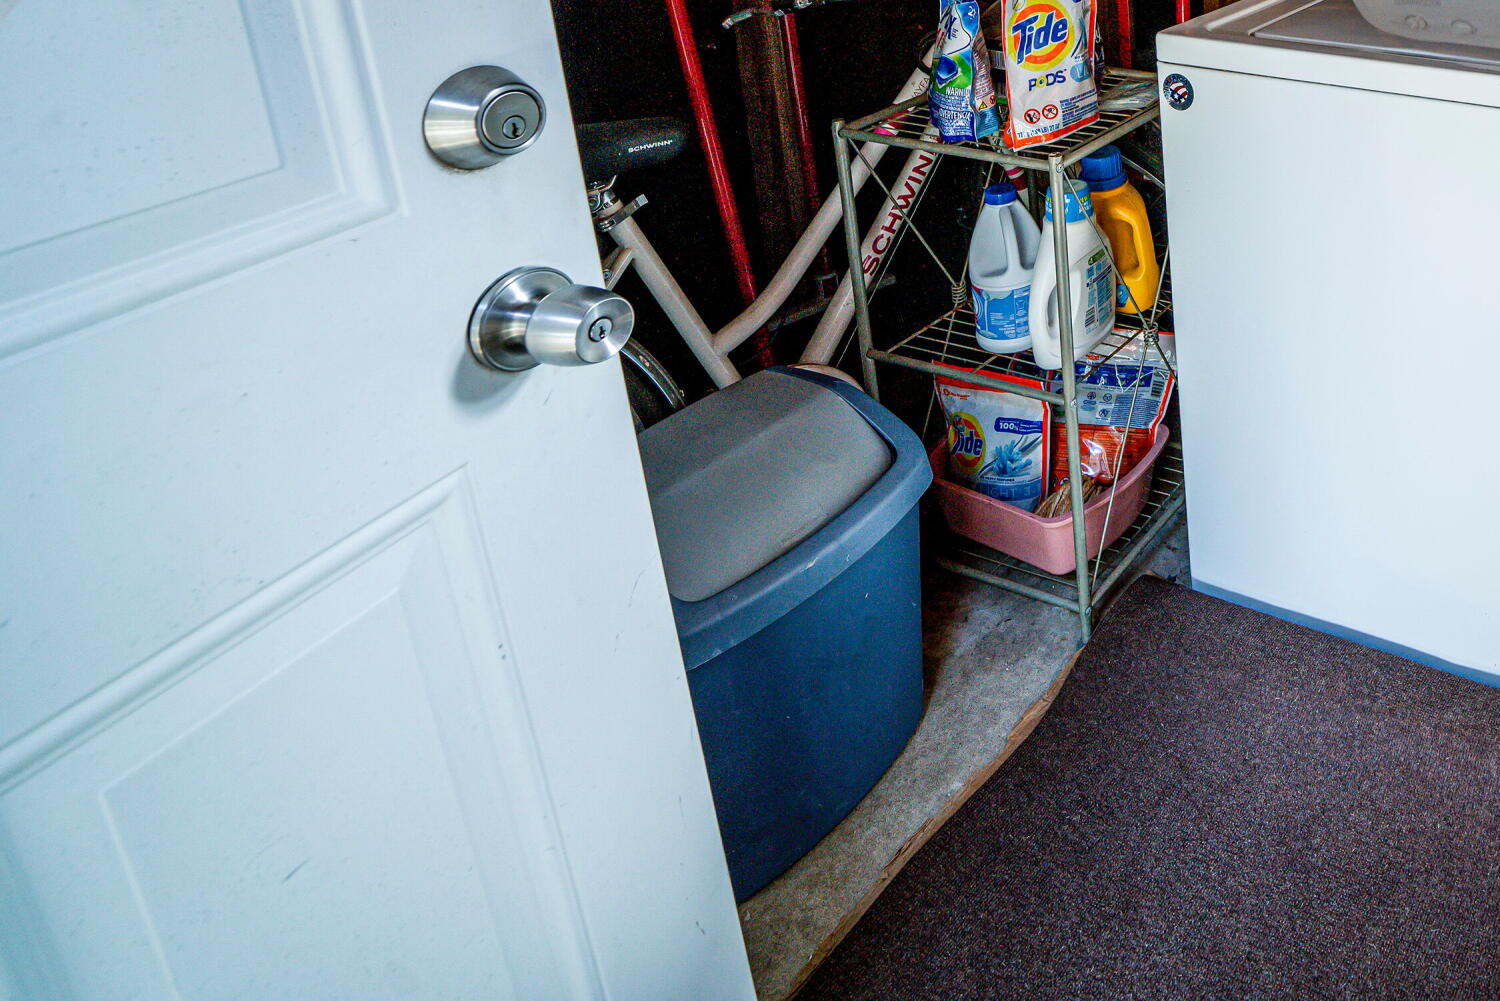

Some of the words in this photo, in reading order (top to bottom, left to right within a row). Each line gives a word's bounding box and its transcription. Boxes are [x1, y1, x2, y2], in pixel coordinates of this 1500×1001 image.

[1011, 10, 1069, 65] Tide
[1028, 70, 1067, 92] PODS
[628, 139, 672, 153] SCHWINN
[999, 422, 1019, 431] 100%
